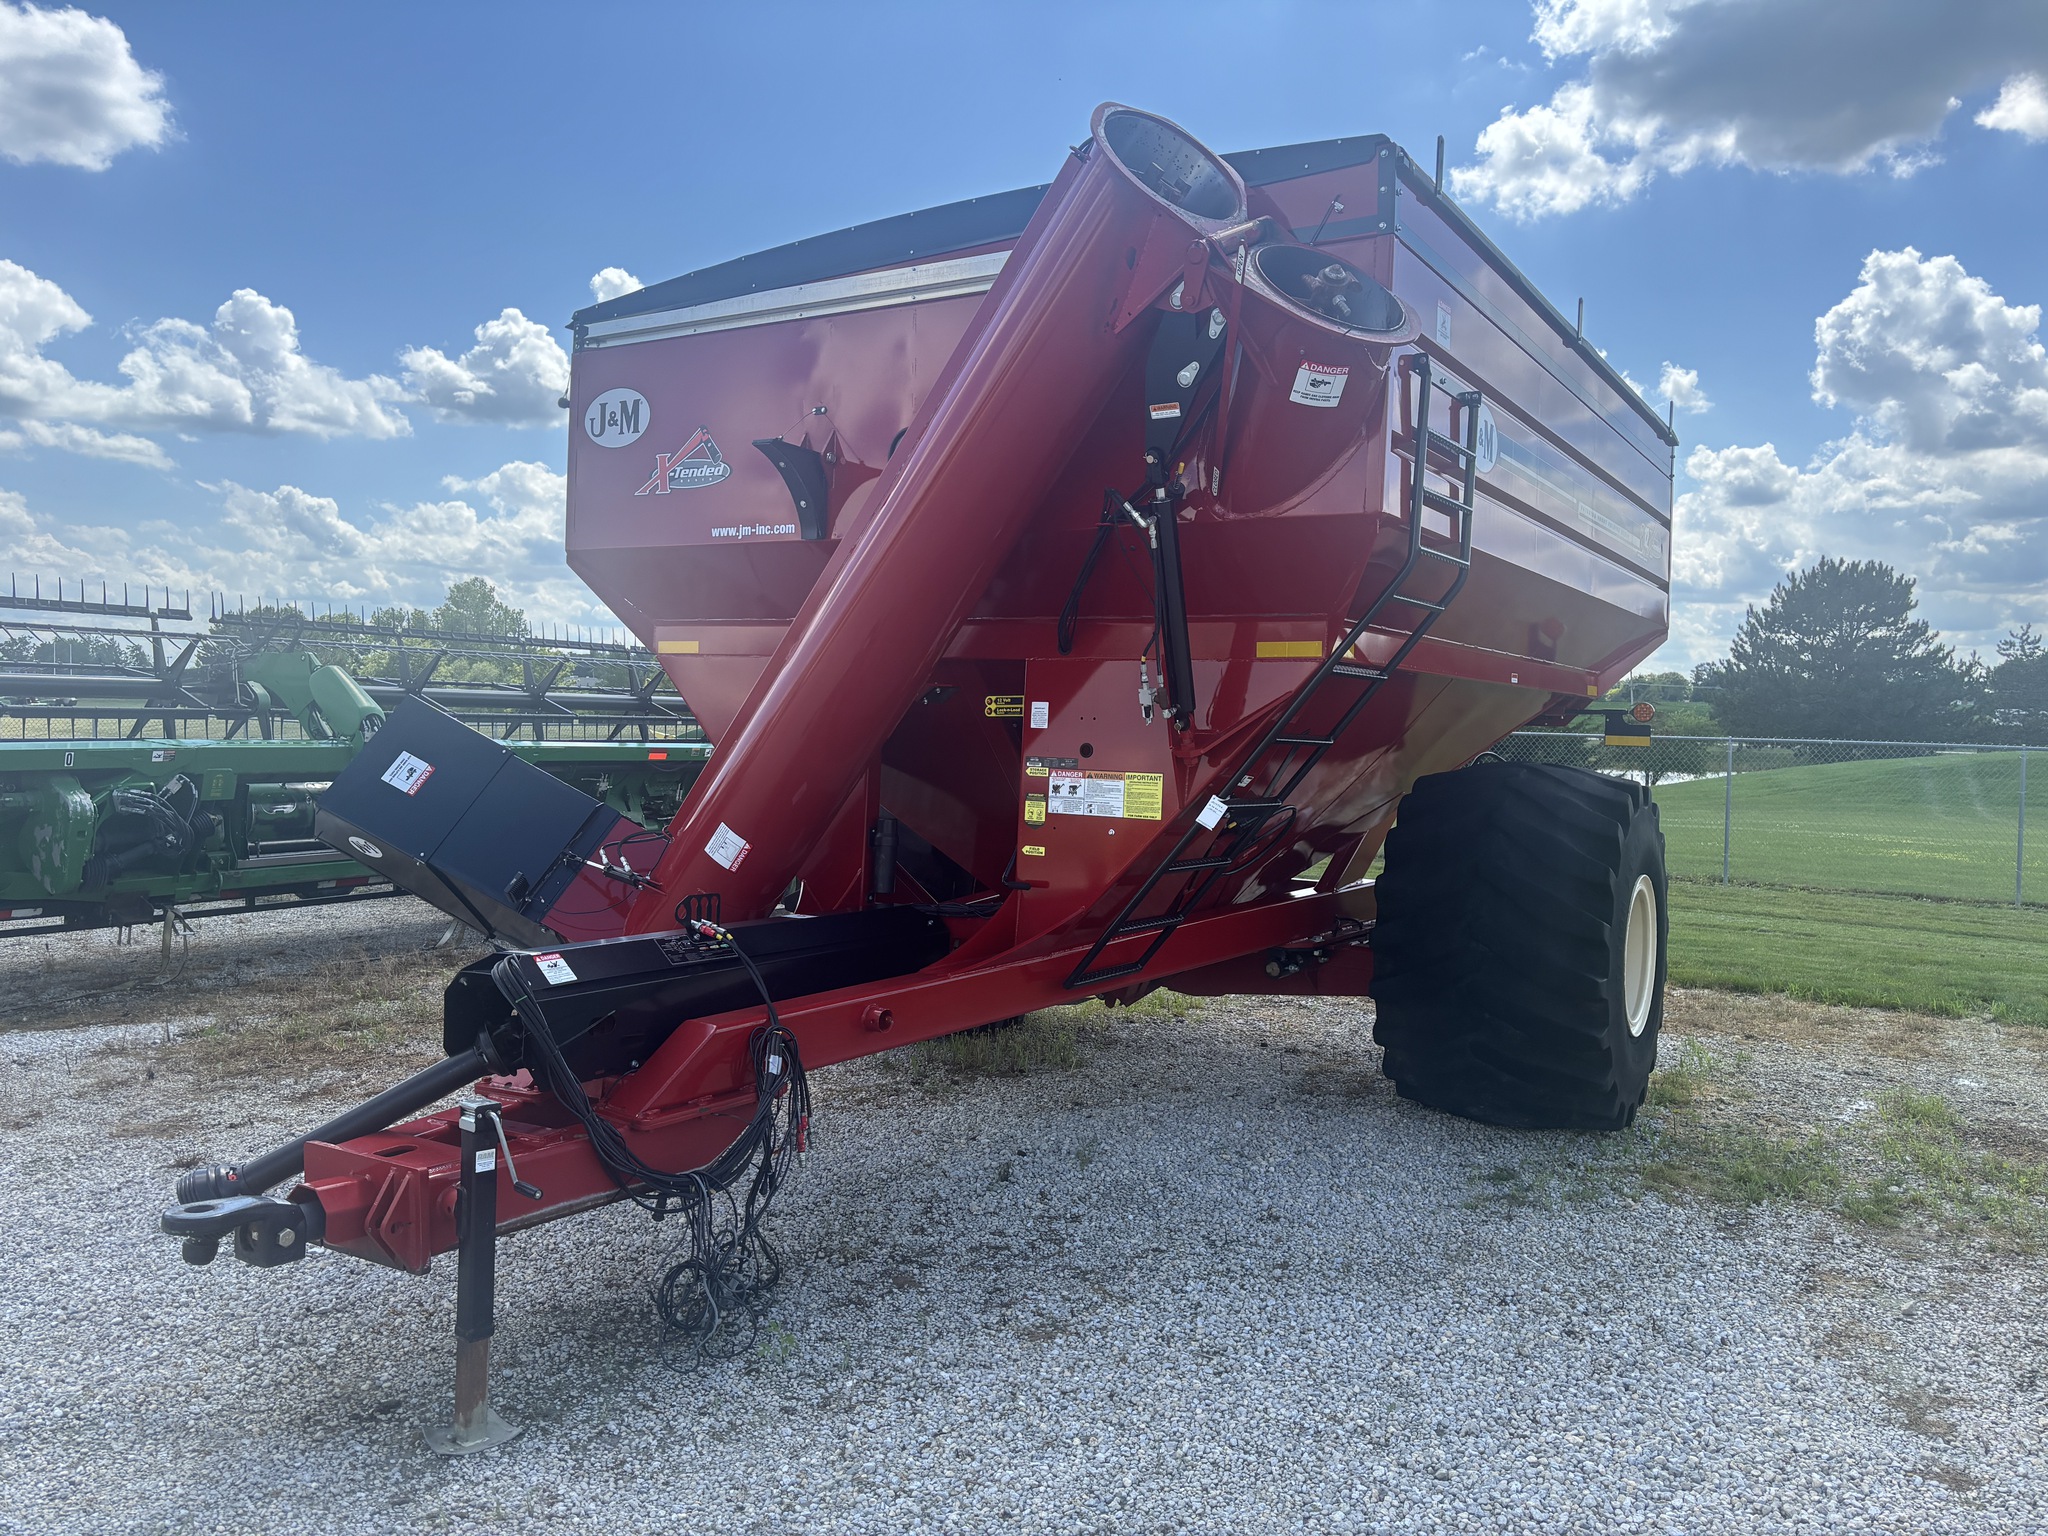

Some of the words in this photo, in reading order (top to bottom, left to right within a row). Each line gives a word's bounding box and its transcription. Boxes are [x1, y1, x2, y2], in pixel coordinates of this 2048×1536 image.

[1236, 253, 1244, 276] OPEN
[1310, 364, 1349, 374] DANGER
[589, 398, 643, 438] J&M
[1479, 420, 1494, 463] &M
[711, 523, 796, 540] www.jm-inc.com
[408, 770, 430, 795] DANGER
[1125, 774, 1162, 782] IMPORTANT
[730, 849, 748, 872] DANGER
